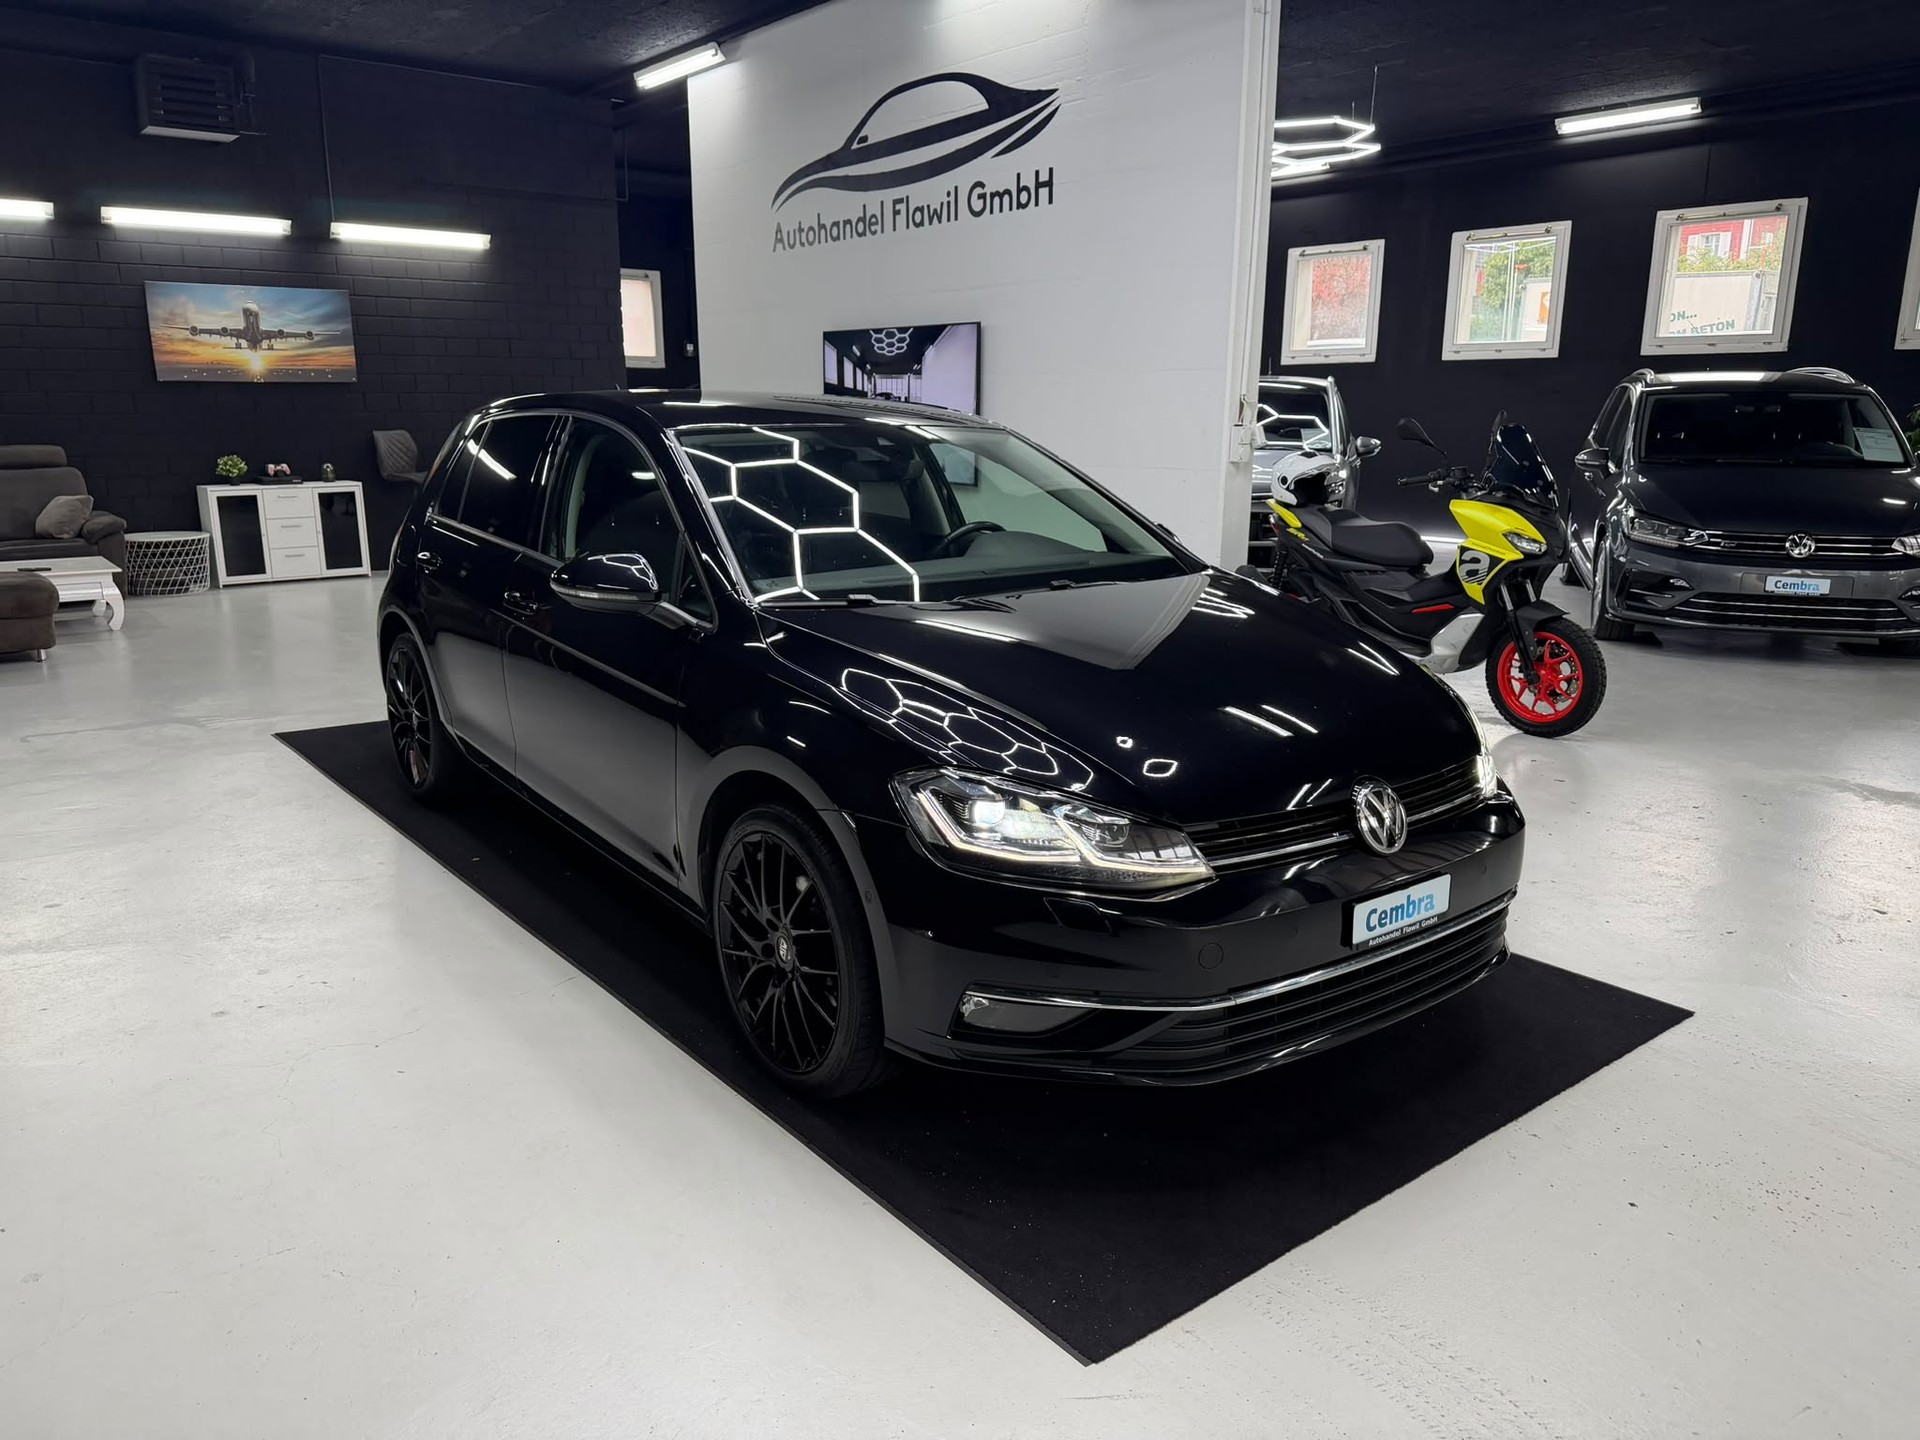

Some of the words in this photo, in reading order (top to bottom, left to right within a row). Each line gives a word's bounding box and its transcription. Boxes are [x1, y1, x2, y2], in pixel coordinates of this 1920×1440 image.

[772, 200, 884, 252] Autohandel
[892, 186, 959, 232] Flawil
[966, 167, 1054, 218] GmbH
[1774, 580, 1820, 591] Cembra
[1365, 893, 1435, 933] Cembra
[1368, 930, 1402, 947] Autohandel
[1402, 923, 1420, 934] Flawil
[1421, 915, 1438, 928] GmbH
